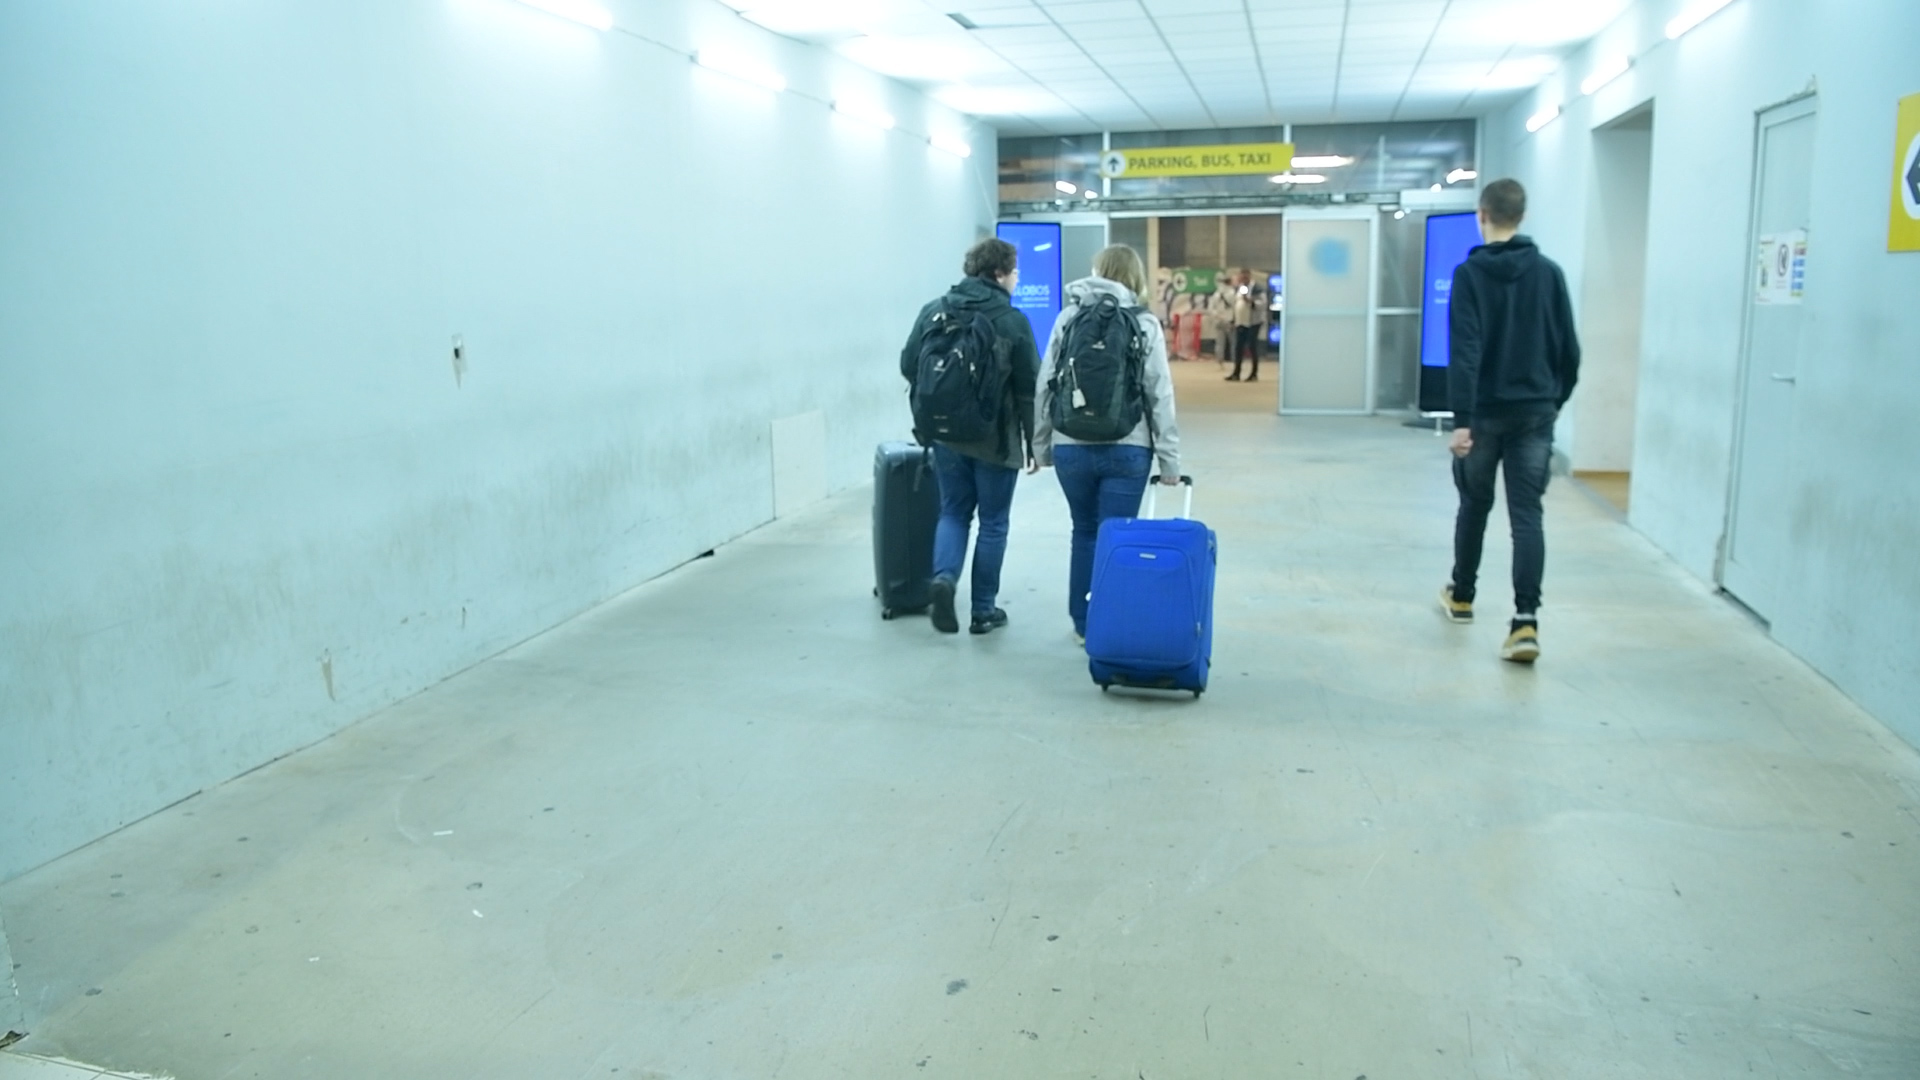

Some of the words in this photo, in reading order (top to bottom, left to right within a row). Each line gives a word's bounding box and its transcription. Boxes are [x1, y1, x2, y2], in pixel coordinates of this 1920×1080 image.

[1128, 155, 1197, 170] PARKING,
[1201, 153, 1235, 168] BUS,
[1238, 152, 1271, 165] TAXI
